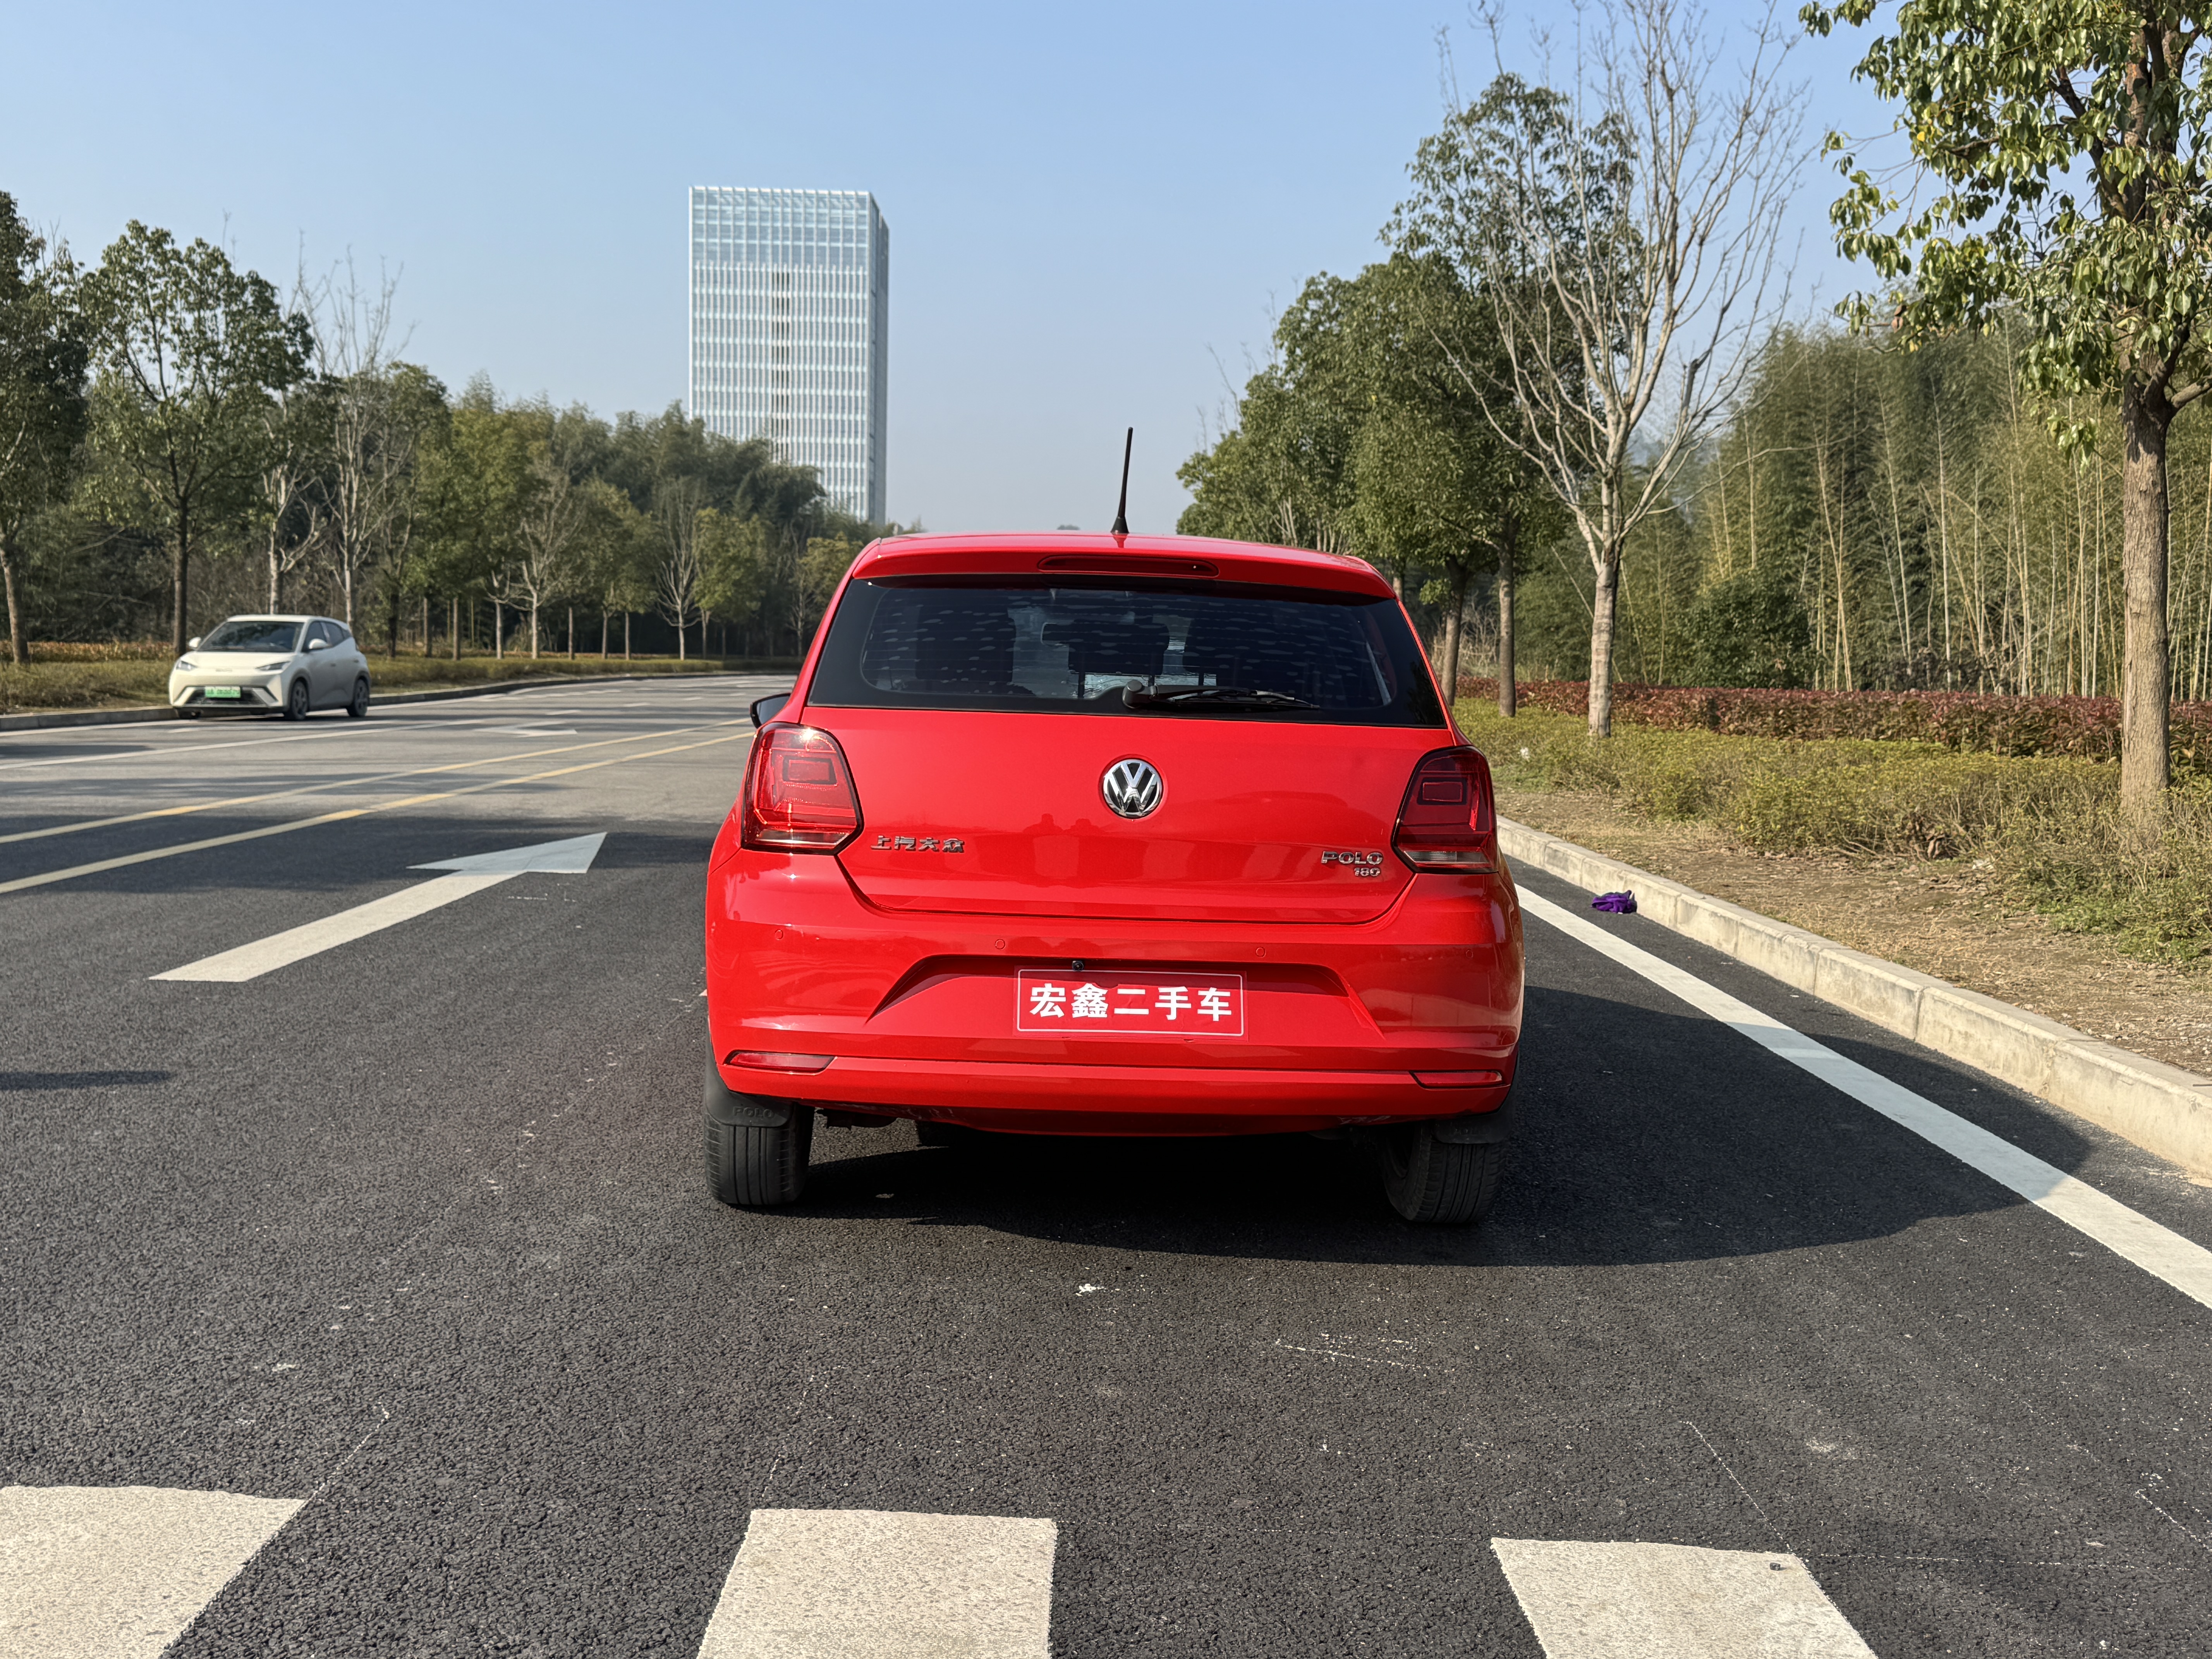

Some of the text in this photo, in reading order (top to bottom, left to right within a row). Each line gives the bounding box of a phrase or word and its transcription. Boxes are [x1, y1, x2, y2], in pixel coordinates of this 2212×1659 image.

[870, 835, 964, 853] 上汽大众
[1321, 851, 1384, 865] POLO
[1354, 867, 1381, 877] 180
[1029, 982, 1232, 1022] 宏鑫二手车
[733, 1106, 775, 1119] POLO
